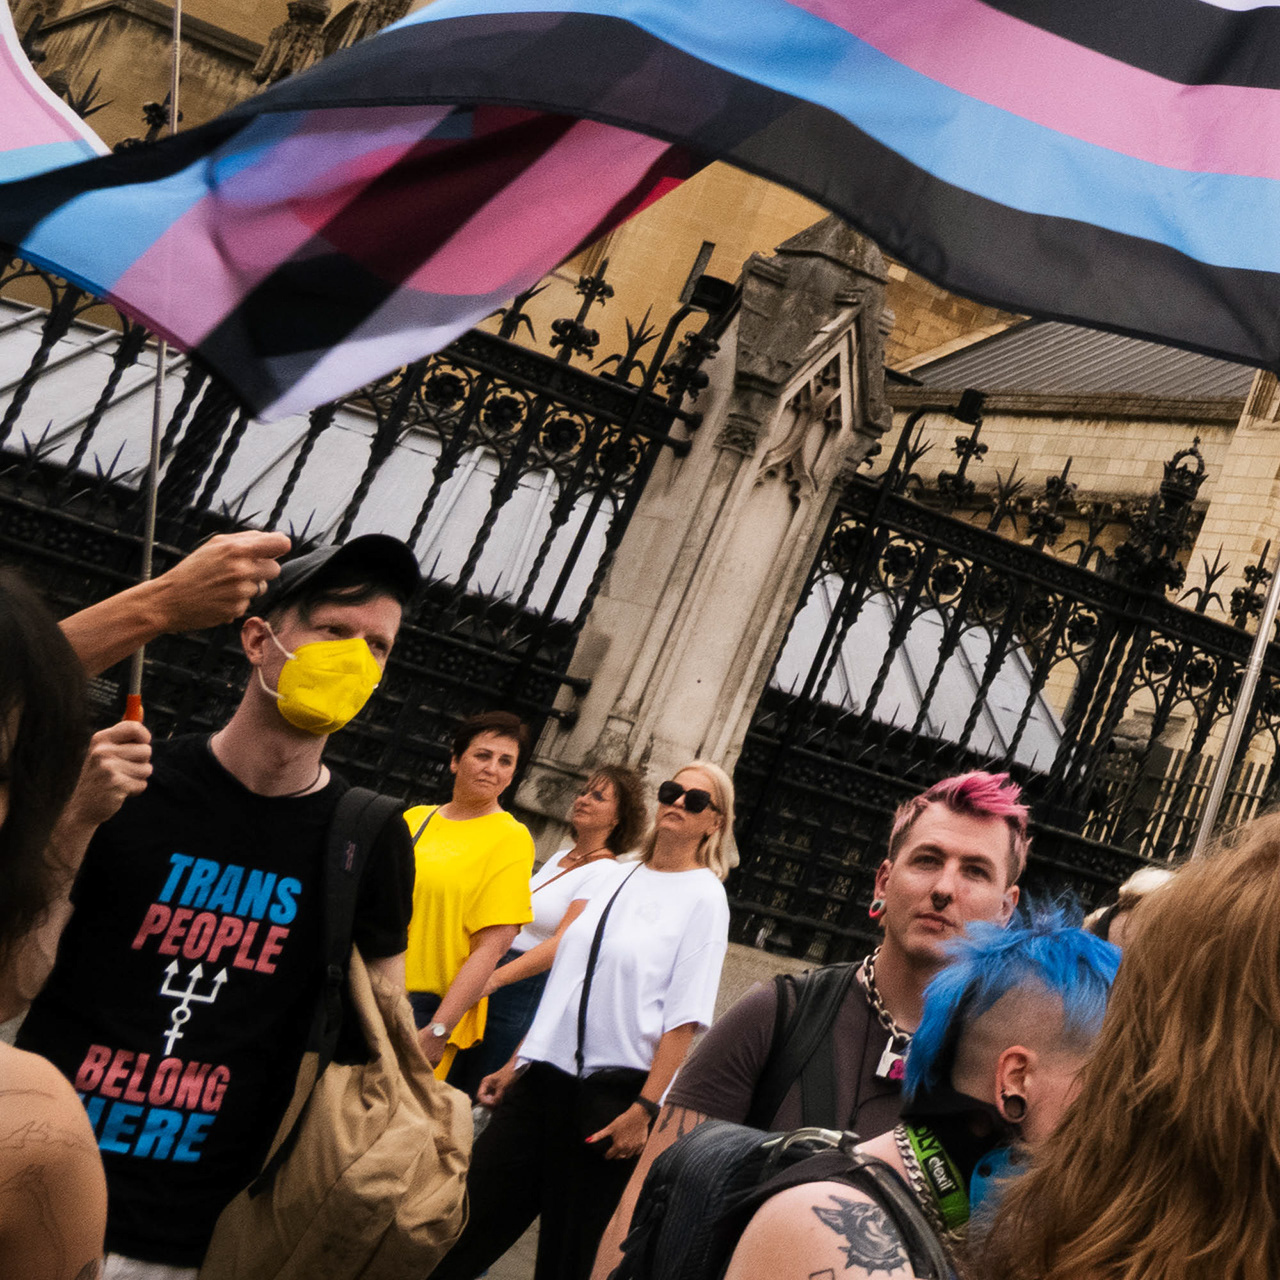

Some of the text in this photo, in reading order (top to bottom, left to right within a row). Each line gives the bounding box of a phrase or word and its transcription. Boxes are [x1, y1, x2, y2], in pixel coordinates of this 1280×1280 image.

[158, 852, 302, 924] TRANS
[131, 903, 290, 974] PEOPLE
[74, 1044, 231, 1111] BELONG
